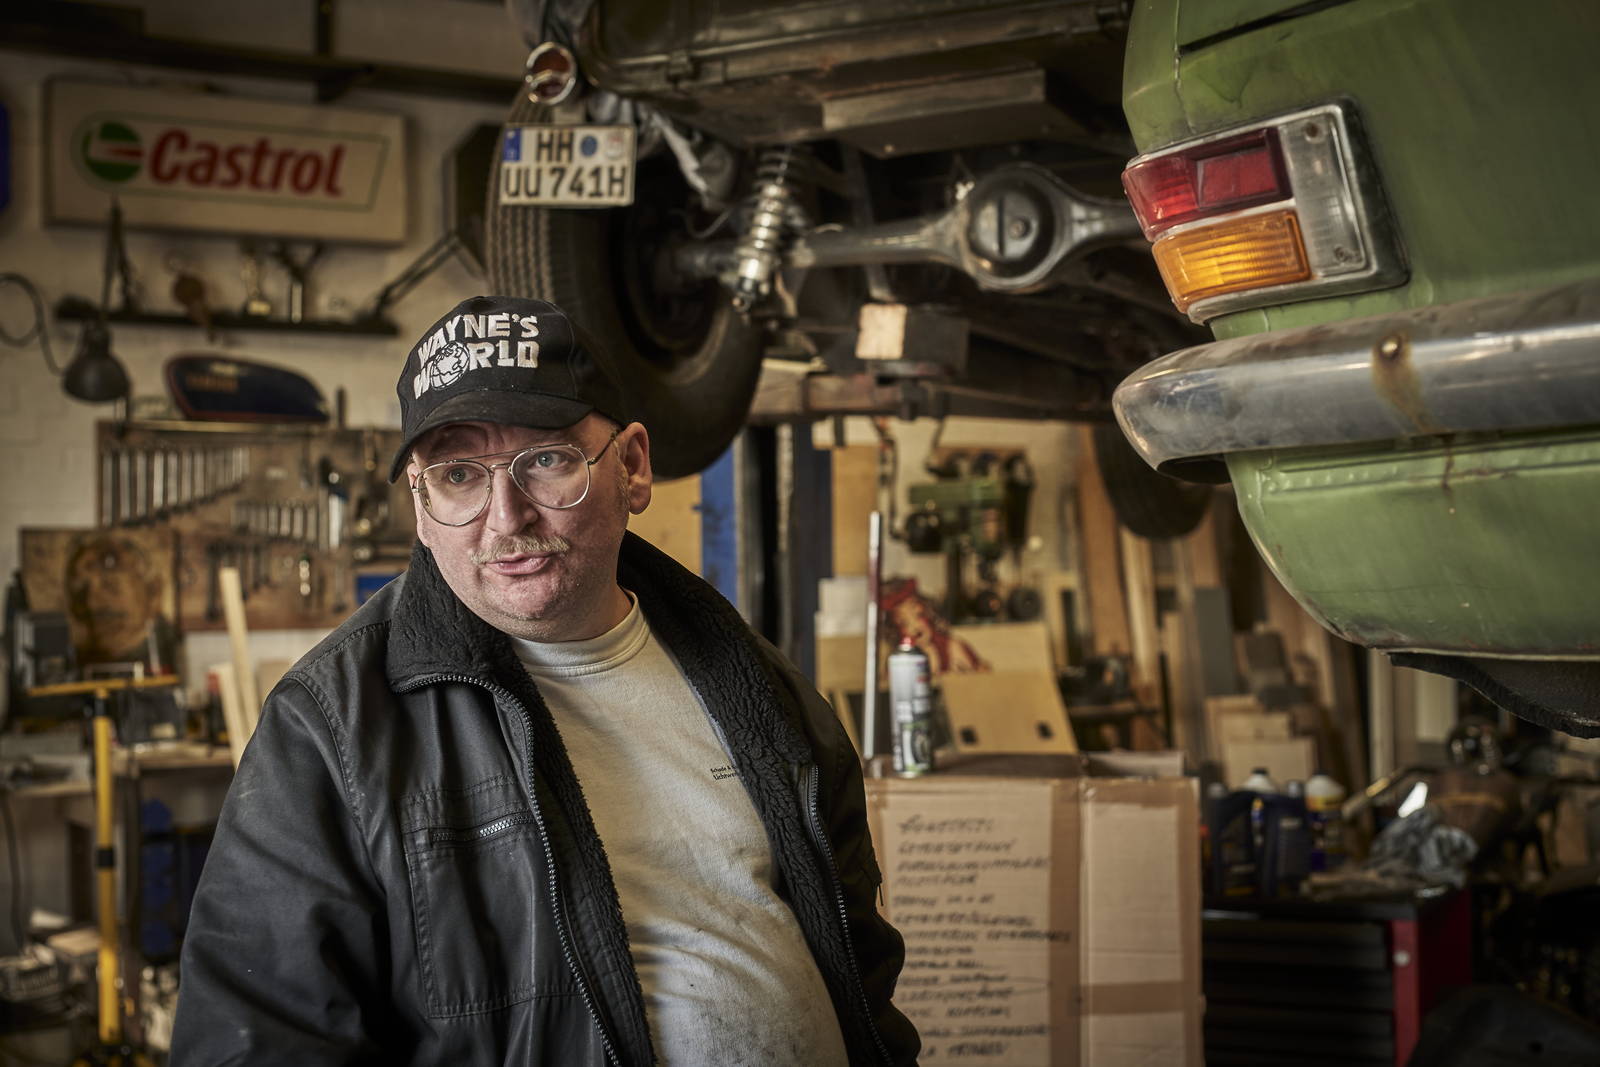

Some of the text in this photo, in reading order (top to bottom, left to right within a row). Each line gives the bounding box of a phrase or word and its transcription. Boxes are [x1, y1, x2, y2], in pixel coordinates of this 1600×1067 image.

[150, 127, 347, 197] Castrol
[536, 130, 573, 162] HH
[504, 165, 627, 197] UU 741H
[418, 312, 539, 369] WAYNE'S
